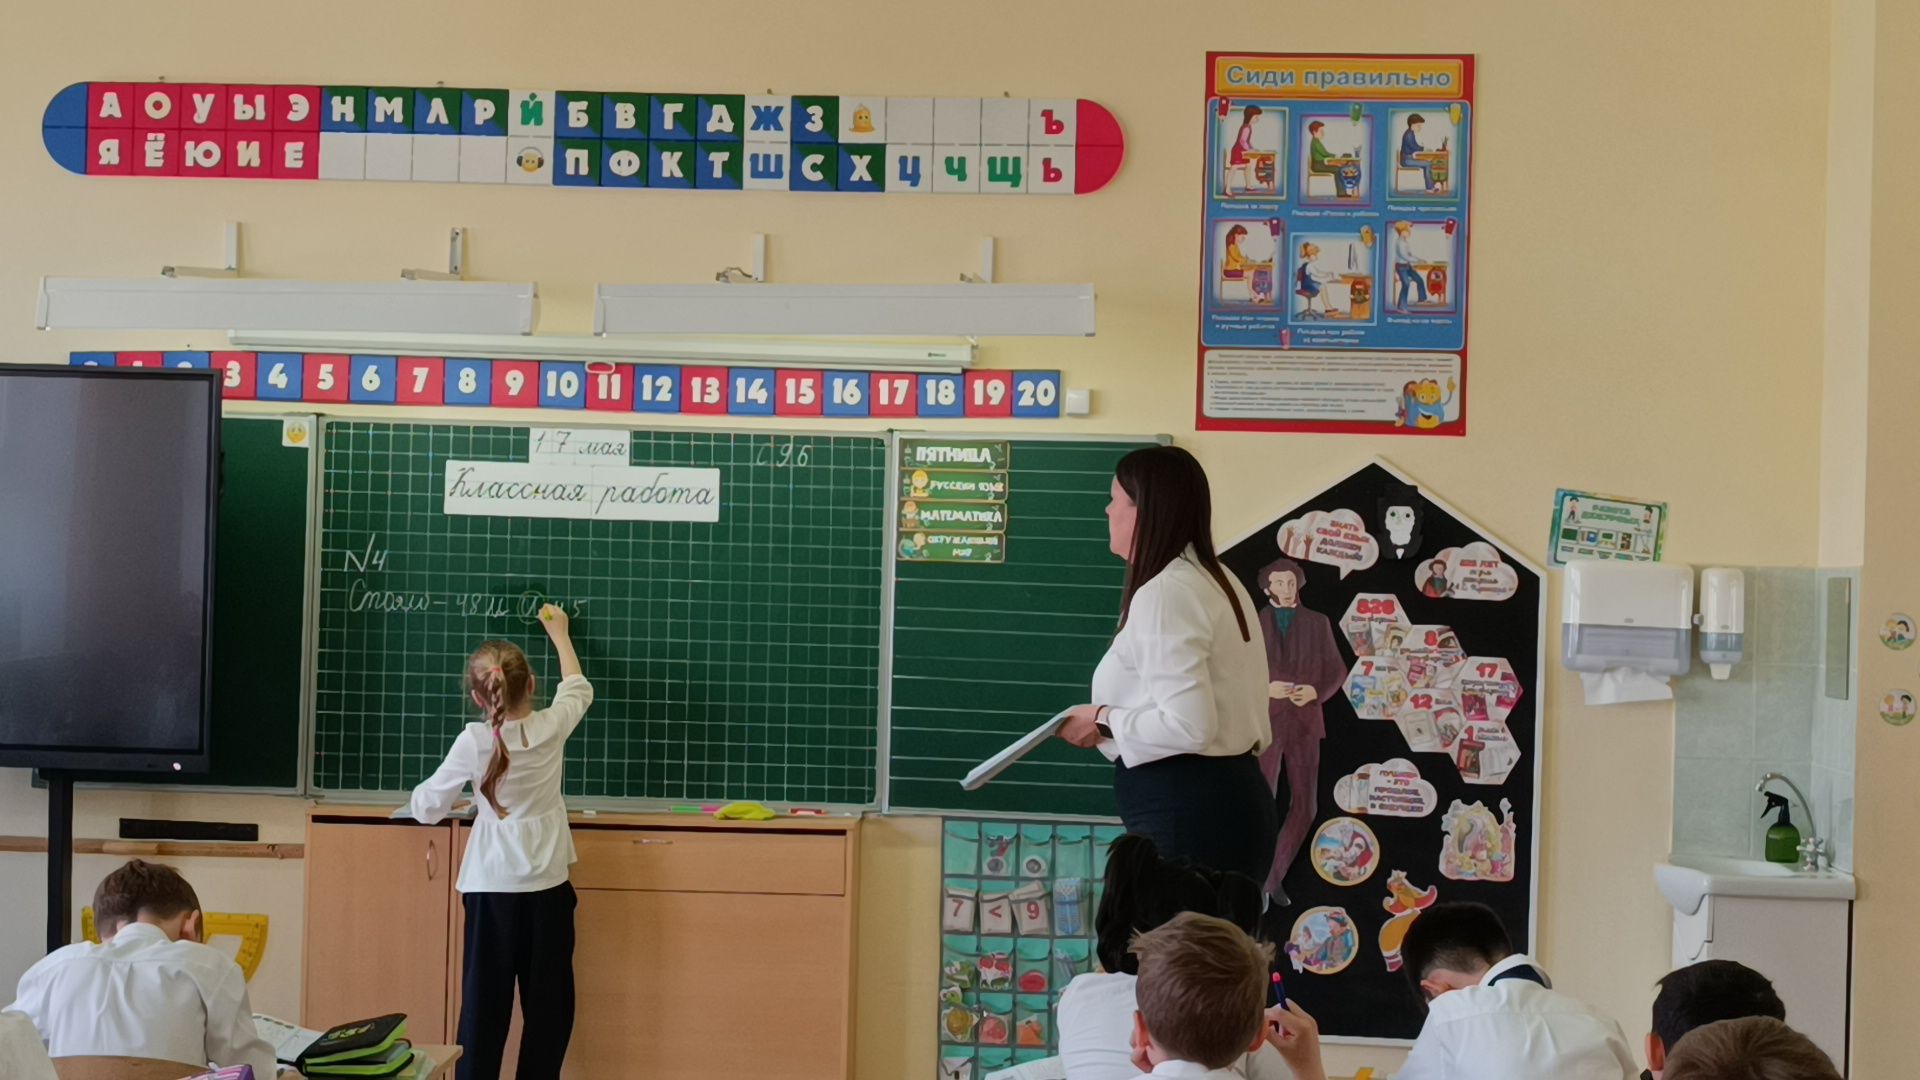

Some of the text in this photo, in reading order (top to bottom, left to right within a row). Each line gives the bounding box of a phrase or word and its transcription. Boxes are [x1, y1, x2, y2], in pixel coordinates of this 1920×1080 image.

[1226, 65, 1453, 90] Сиди правильно
[101, 93, 1065, 135] А О У Ы Э Н М Л Р Й Б В Г Д Ж З Ъ
[99, 133, 1063, 187] Я Ё Ю И Е П Ф К Т Ш С Х Ц Ч Щ Ь
[224, 360, 1056, 407] 3 4 5 6 7 8 9 10 11 12 13 14 15 16 17 18 19 20
[577, 440, 627, 455] мая
[916, 446, 991, 462] ПЯТНИЦА
[449, 467, 716, 515] Классная работа
[930, 480, 976, 491] РУССКИЙ
[921, 510, 1002, 522] МАТЕМАТИКА
[1361, 660, 1375, 677] 7
[1476, 663, 1499, 678] 17
[951, 898, 964, 917] 7
[1026, 901, 1041, 920] 9
